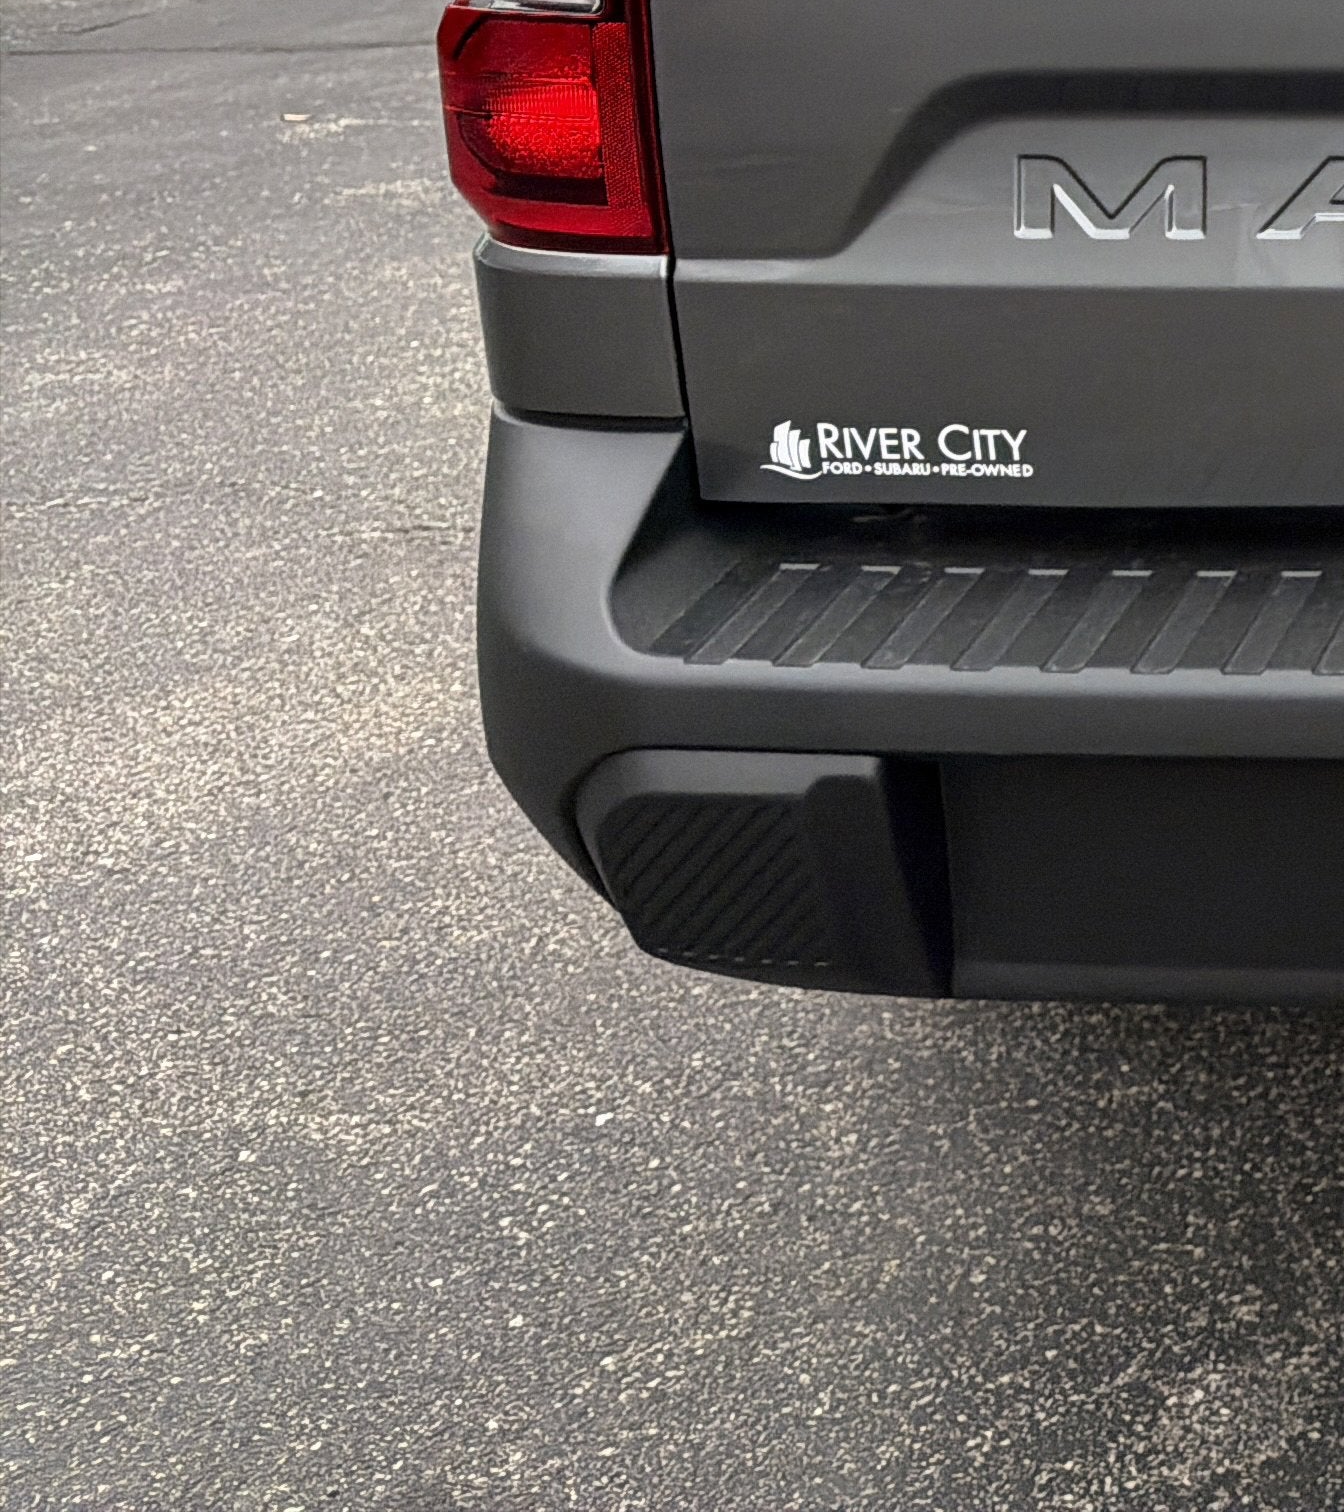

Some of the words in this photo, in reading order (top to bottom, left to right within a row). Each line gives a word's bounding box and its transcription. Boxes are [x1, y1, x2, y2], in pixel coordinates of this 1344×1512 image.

[816, 422, 925, 460] RIVER
[937, 423, 1027, 461] CITY
[822, 461, 863, 475] FORD
[874, 462, 931, 476] SUBARU
[941, 462, 1034, 477] PRE-OWNED
